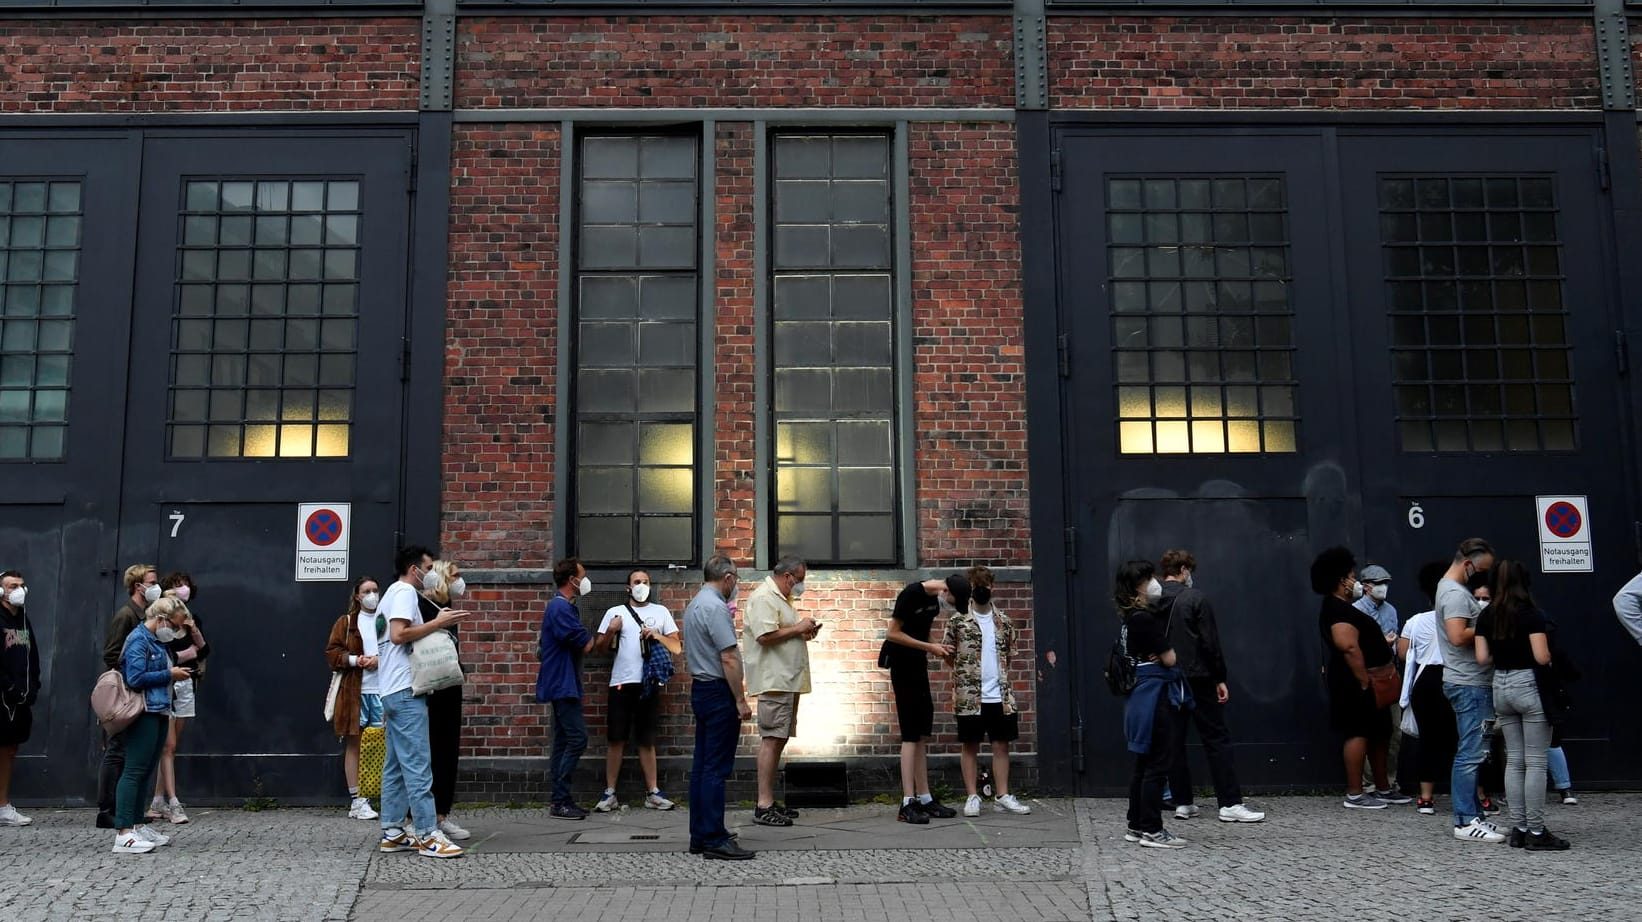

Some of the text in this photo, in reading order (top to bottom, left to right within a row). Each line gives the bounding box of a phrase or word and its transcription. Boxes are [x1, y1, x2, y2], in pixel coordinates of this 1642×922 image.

[1409, 506, 1424, 528] 6
[169, 514, 185, 537] 7
[1544, 548, 1589, 556] Notausgang
[300, 556, 345, 565] Notausgang
